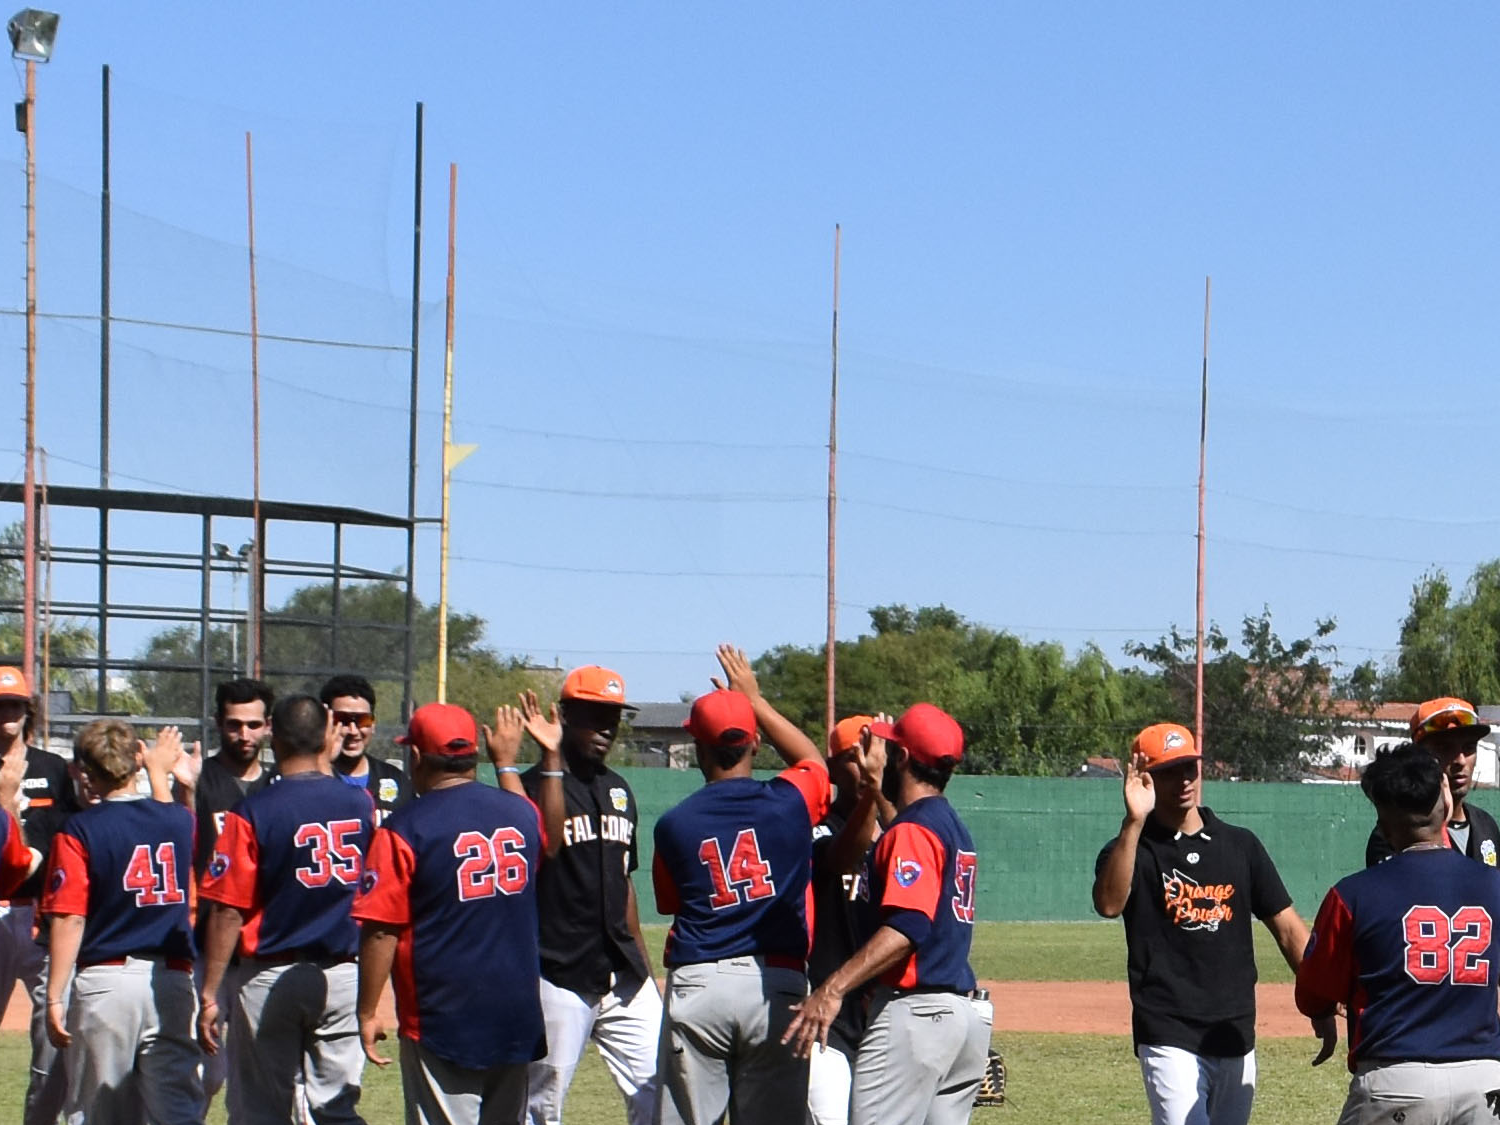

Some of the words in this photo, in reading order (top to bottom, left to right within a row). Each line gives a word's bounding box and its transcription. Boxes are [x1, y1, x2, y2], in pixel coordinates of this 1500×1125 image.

[122, 842, 186, 908] 41
[294, 818, 363, 889] 35
[453, 826, 529, 902] 26
[698, 828, 777, 912] 14
[1165, 879, 1235, 903] Orange
[1166, 898, 1233, 924] Power
[1401, 904, 1493, 987] 82
